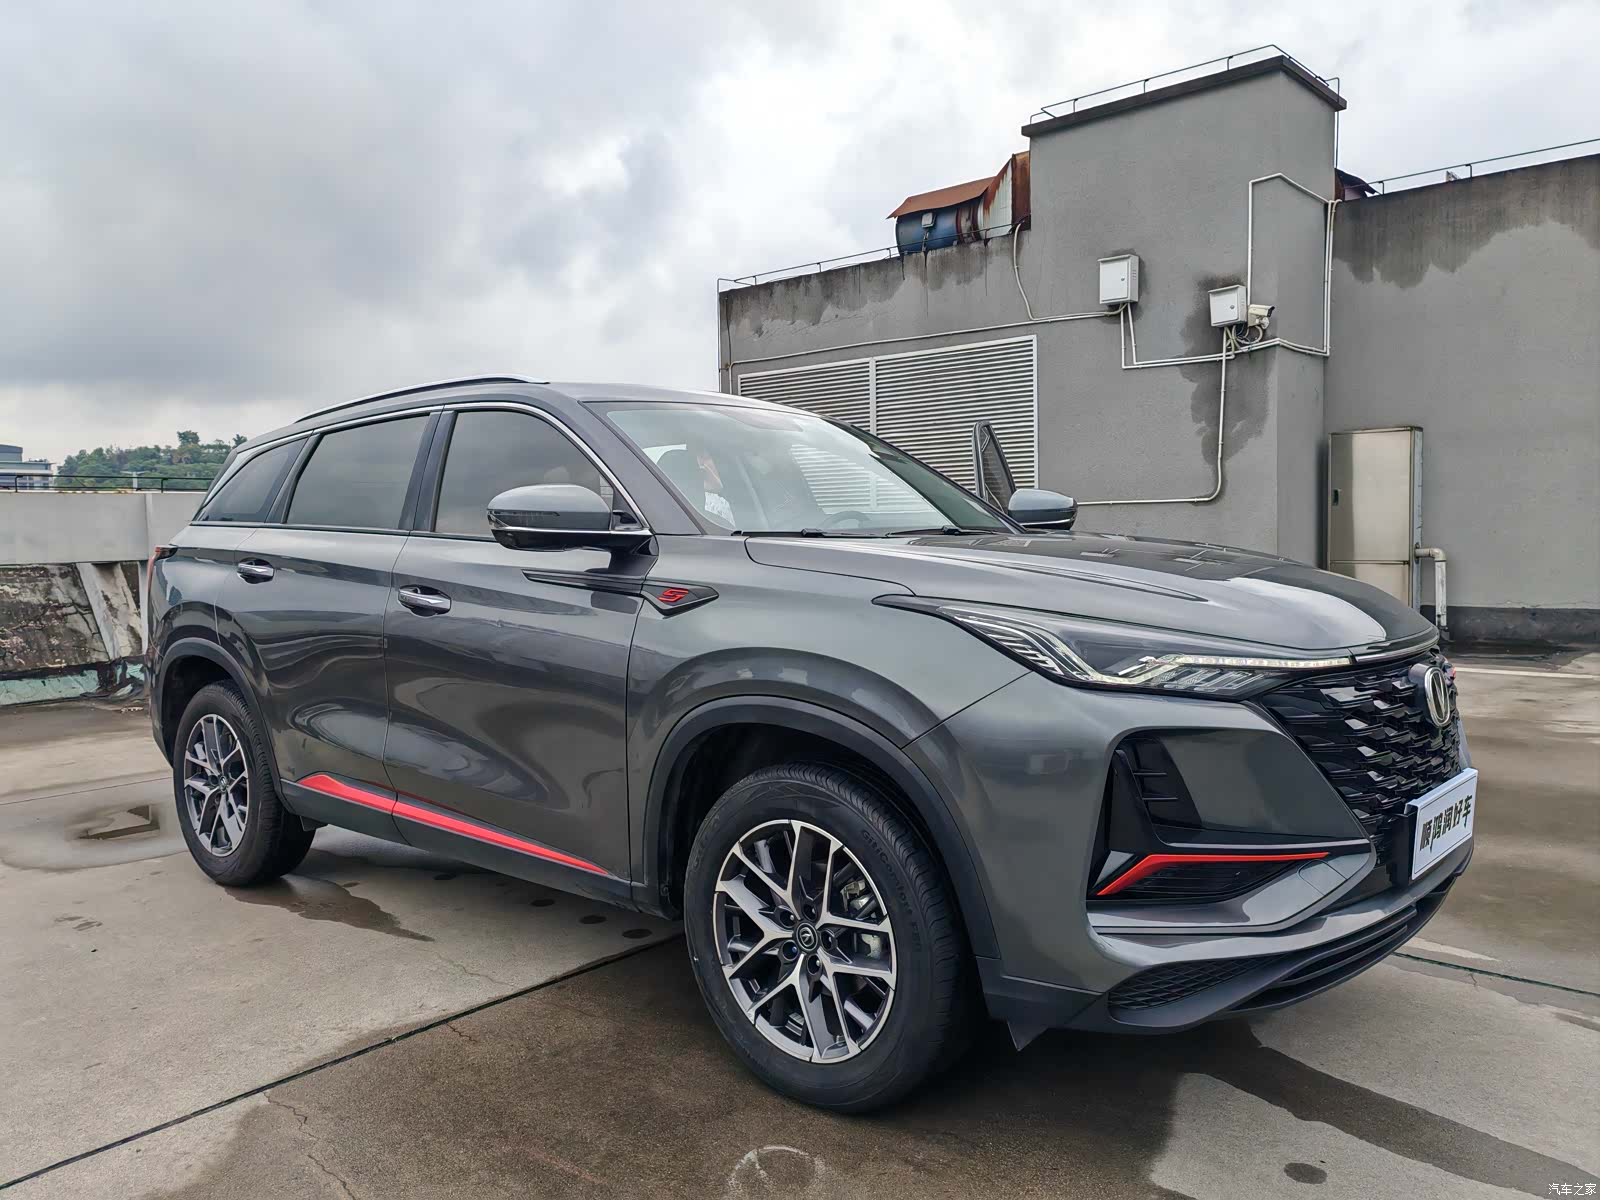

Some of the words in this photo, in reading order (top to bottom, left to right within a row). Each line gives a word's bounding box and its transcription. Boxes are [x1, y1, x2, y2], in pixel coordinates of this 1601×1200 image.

[1420, 795, 1473, 853] 顺鸿润好车
